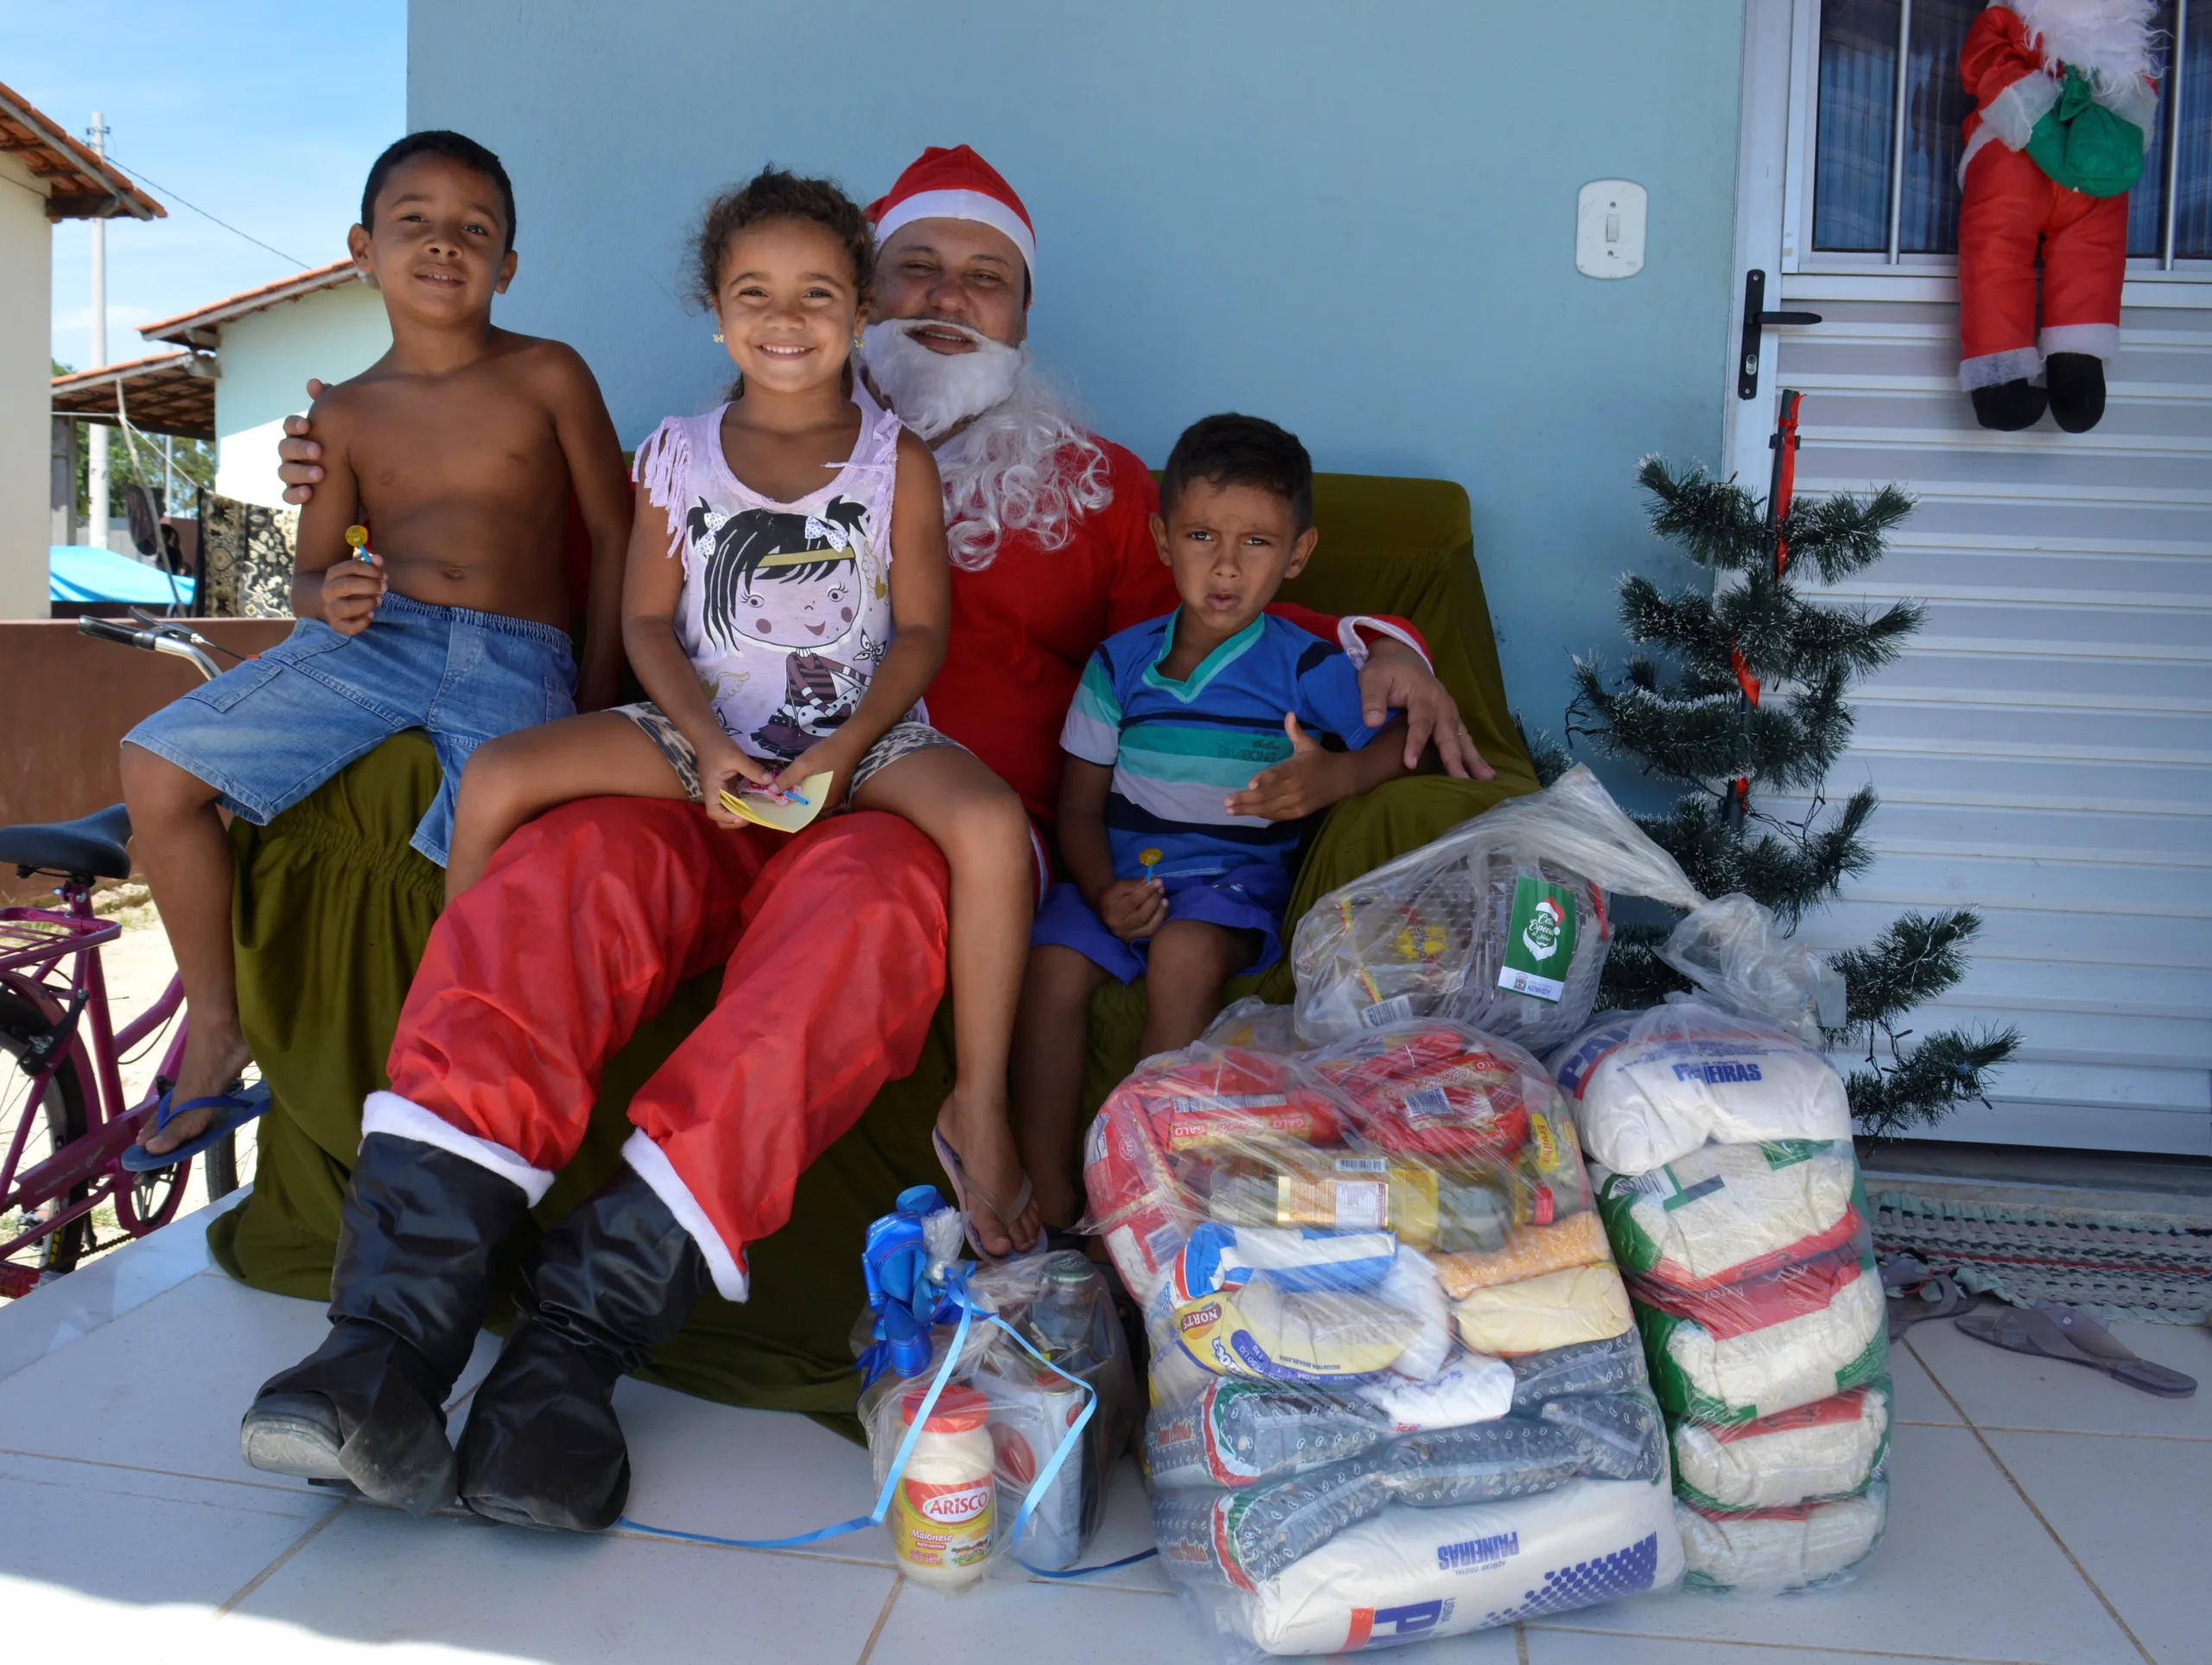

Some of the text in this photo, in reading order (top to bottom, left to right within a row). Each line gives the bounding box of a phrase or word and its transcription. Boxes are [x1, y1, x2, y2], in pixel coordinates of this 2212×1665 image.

[1174, 1125, 1206, 1136] GALO
[1272, 1118, 1304, 1129] GALO
[1537, 1124, 1552, 1164] Ervilha
[911, 1528, 954, 1541] Maionese
[1437, 1531, 1519, 1571] PAINEIRAS
[1440, 1597, 1456, 1623] USINA
